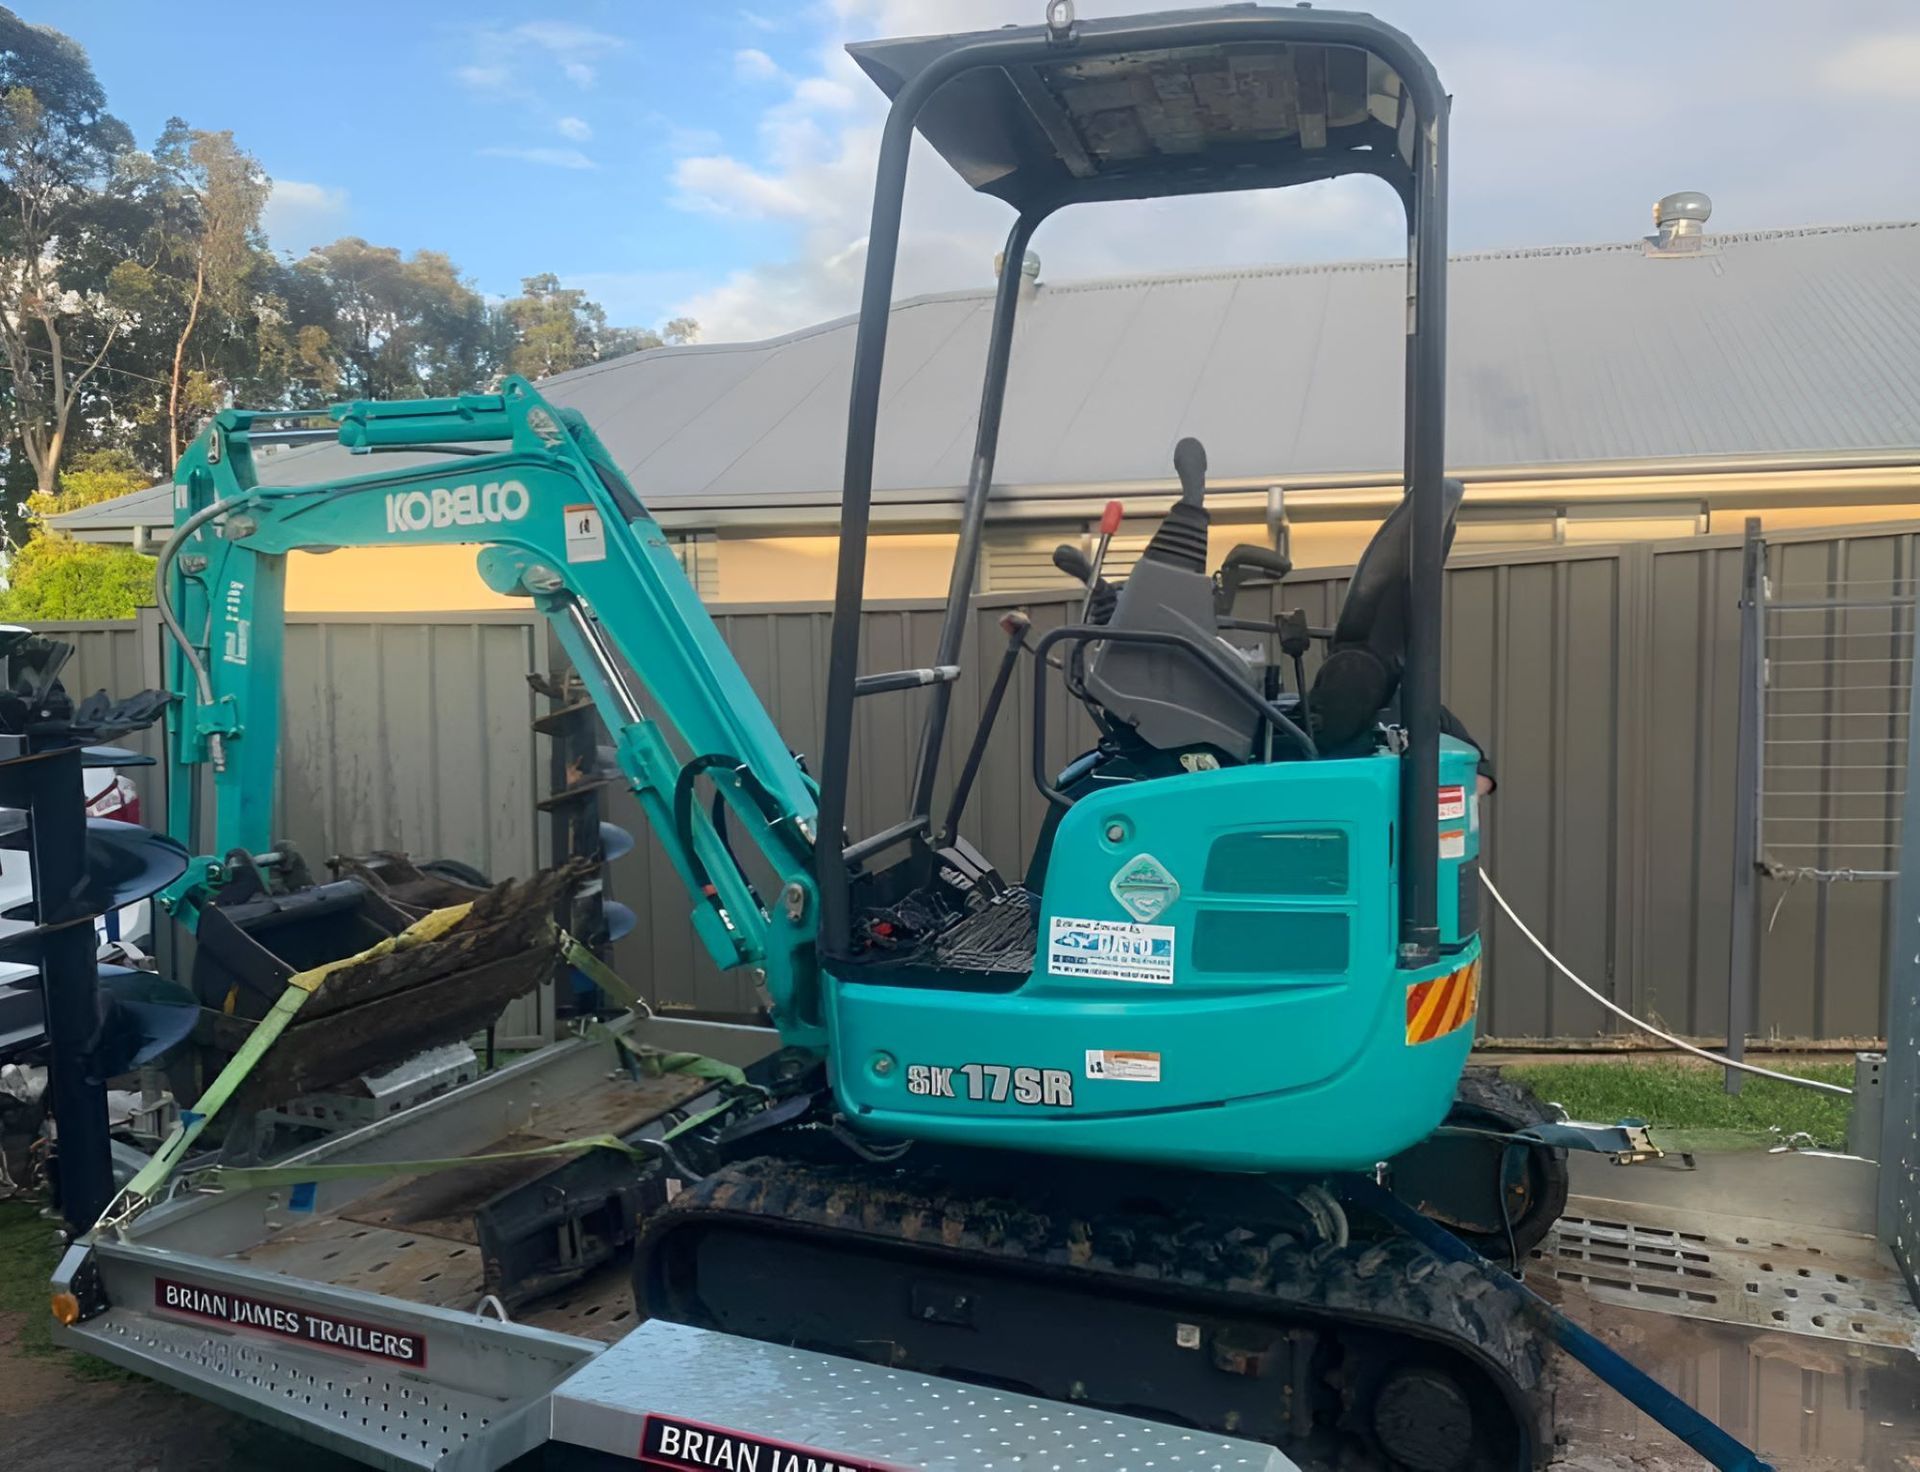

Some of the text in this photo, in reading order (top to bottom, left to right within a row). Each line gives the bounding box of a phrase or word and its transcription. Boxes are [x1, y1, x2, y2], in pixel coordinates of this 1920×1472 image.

[385, 479, 530, 533] KOBELCO
[166, 1285, 413, 1359] BRIAN JAMES TRAILERS
[659, 1425, 760, 1472] BRIAN
